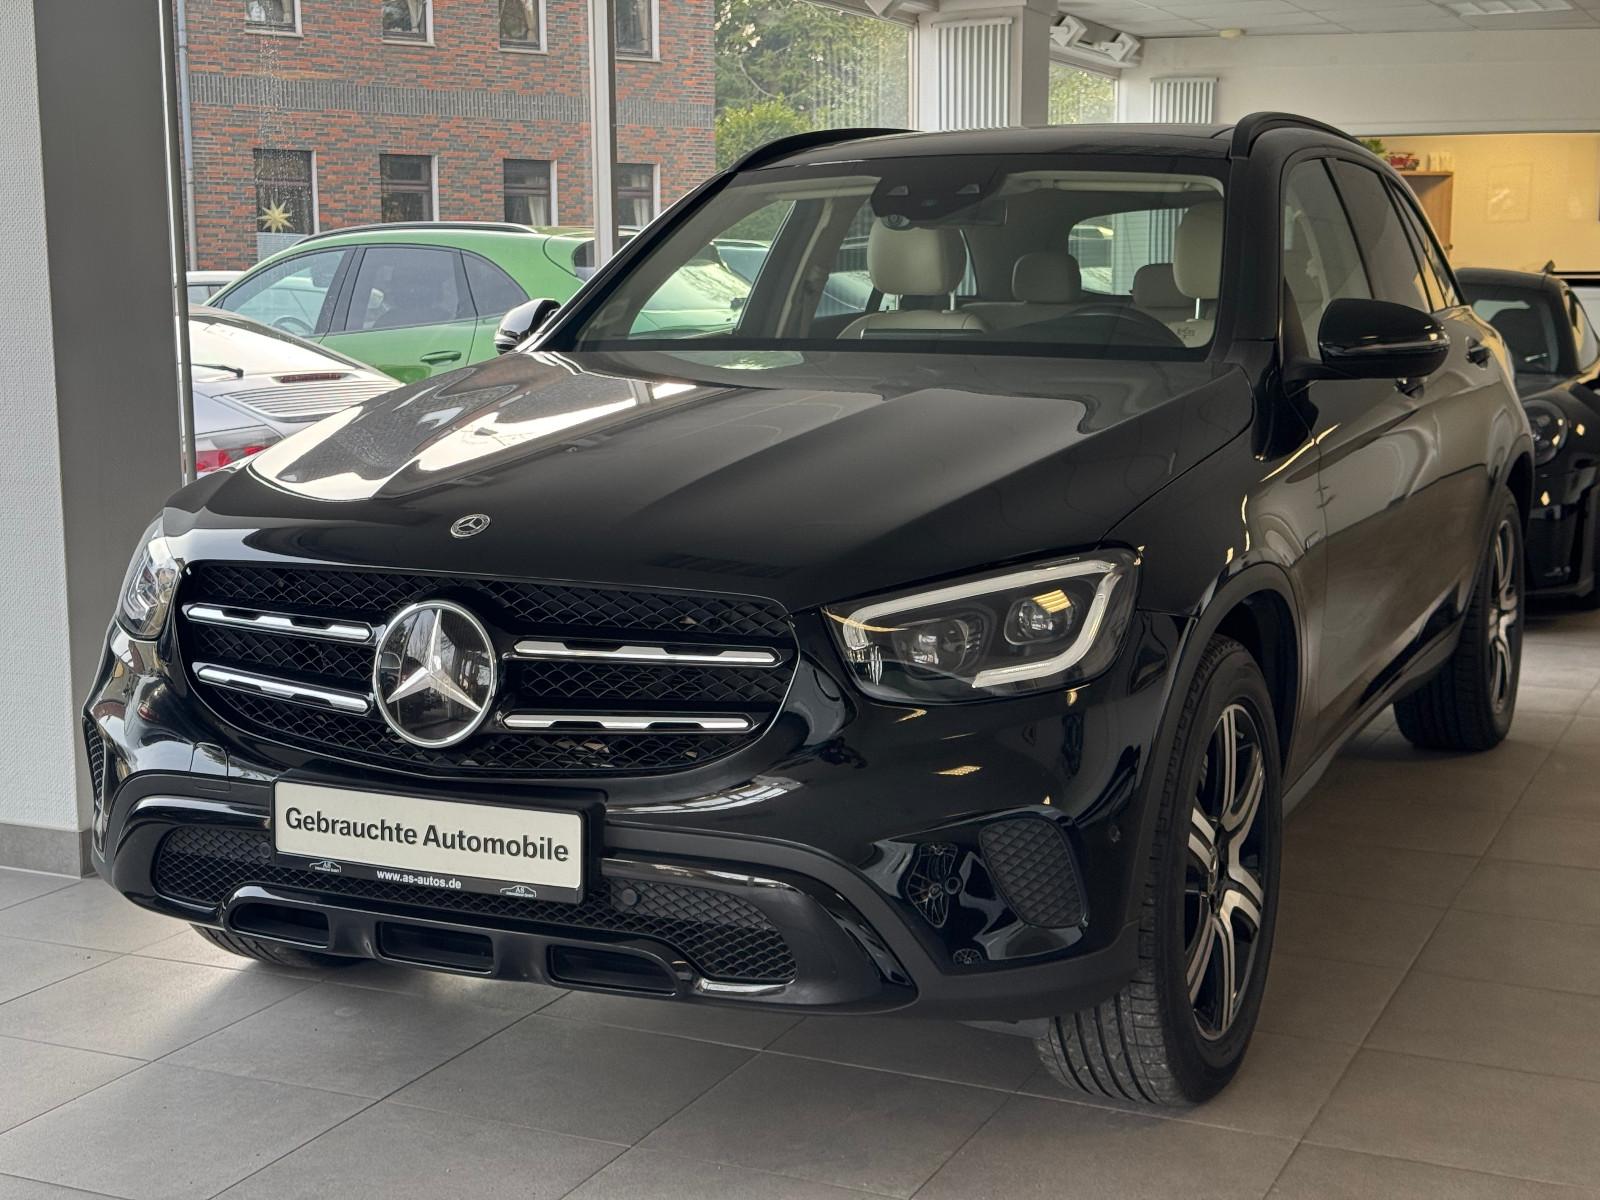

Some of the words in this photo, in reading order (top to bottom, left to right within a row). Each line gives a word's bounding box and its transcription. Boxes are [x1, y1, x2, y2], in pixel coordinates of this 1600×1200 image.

[285, 807, 417, 845] Gebrauchte
[422, 824, 569, 862] Automobile
[376, 870, 462, 889] www.as-autos.de
